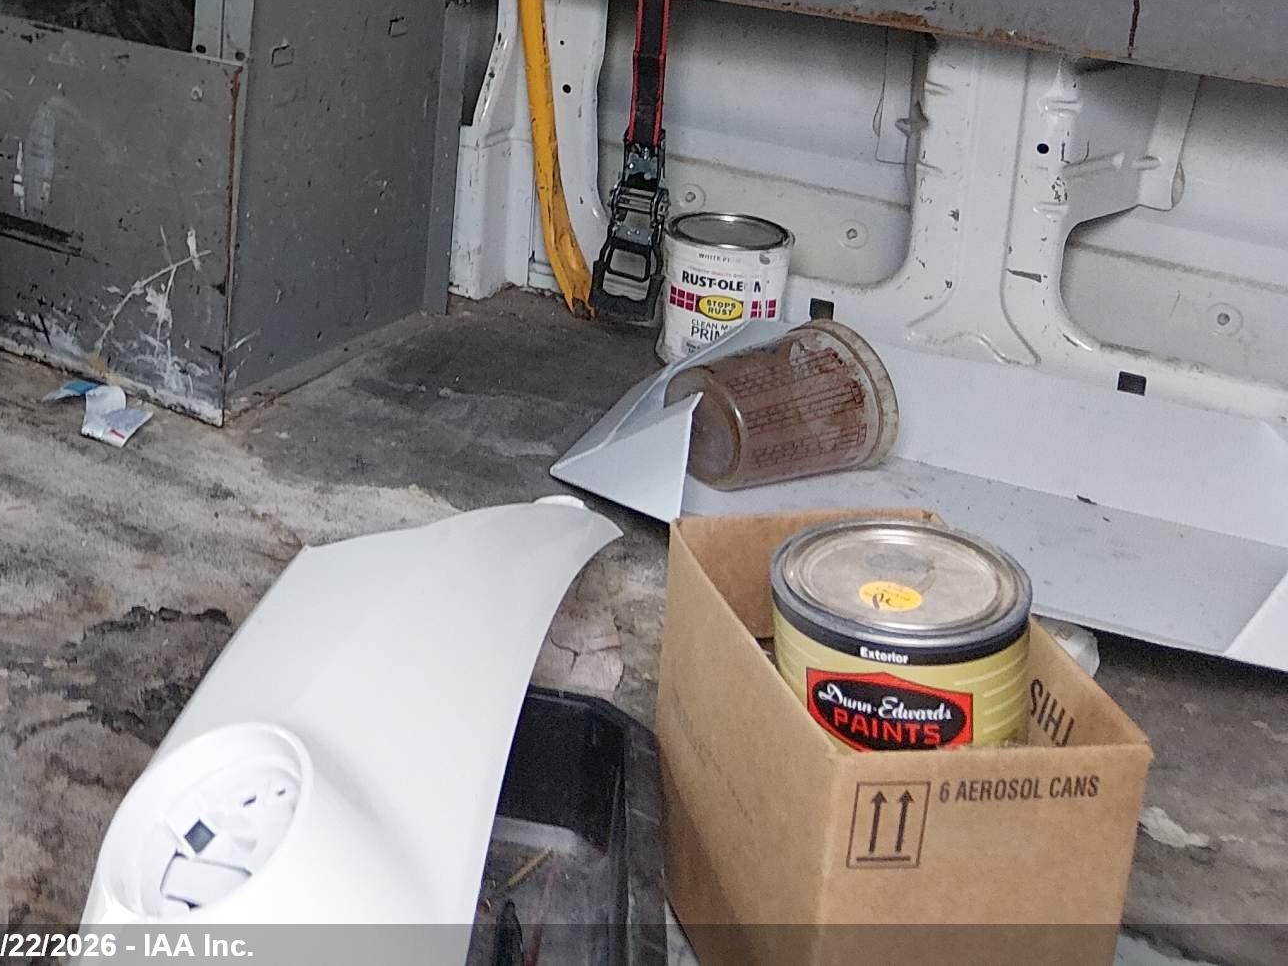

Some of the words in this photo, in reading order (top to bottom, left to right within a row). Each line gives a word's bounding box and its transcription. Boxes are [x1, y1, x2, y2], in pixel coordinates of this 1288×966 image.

[706, 298, 736, 310] STOPS
[707, 306, 734, 317] RUST
[691, 318, 718, 330] CLEAN
[859, 646, 910, 665] Exterior
[818, 682, 953, 722] Dunn-Edwards
[833, 706, 942, 747] PAINTS
[939, 779, 951, 803] 6
[955, 777, 1043, 802] AEROSOL
[1049, 774, 1101, 798] CANS
